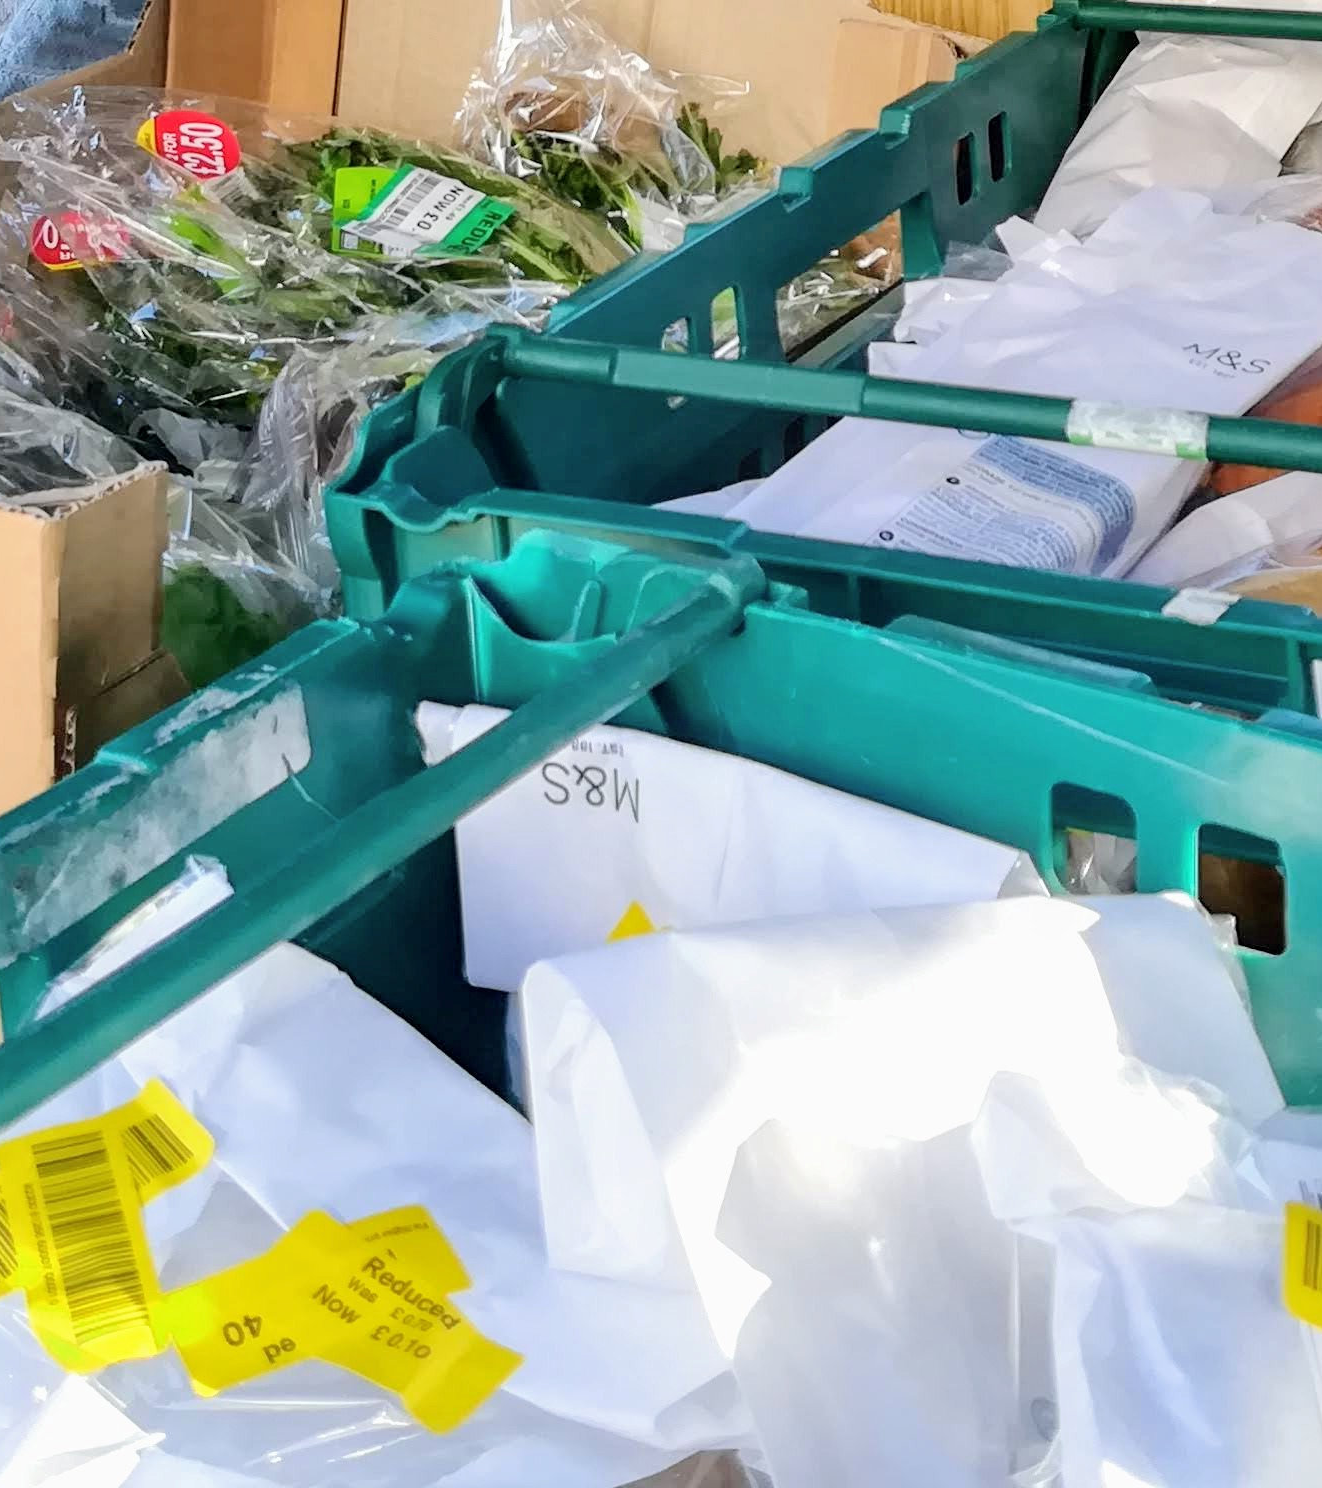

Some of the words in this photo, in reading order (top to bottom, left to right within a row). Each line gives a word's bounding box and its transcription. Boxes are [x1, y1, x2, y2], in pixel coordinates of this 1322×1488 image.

[162, 132, 178, 154] FOR
[179, 122, 227, 175] £2.50
[433, 185, 465, 212] NOW
[1182, 342, 1271, 374] M&S
[541, 761, 640, 824] M&S
[312, 1283, 361, 1324] Now
[347, 1275, 380, 1304] Was
[361, 1254, 462, 1331] Reduced
